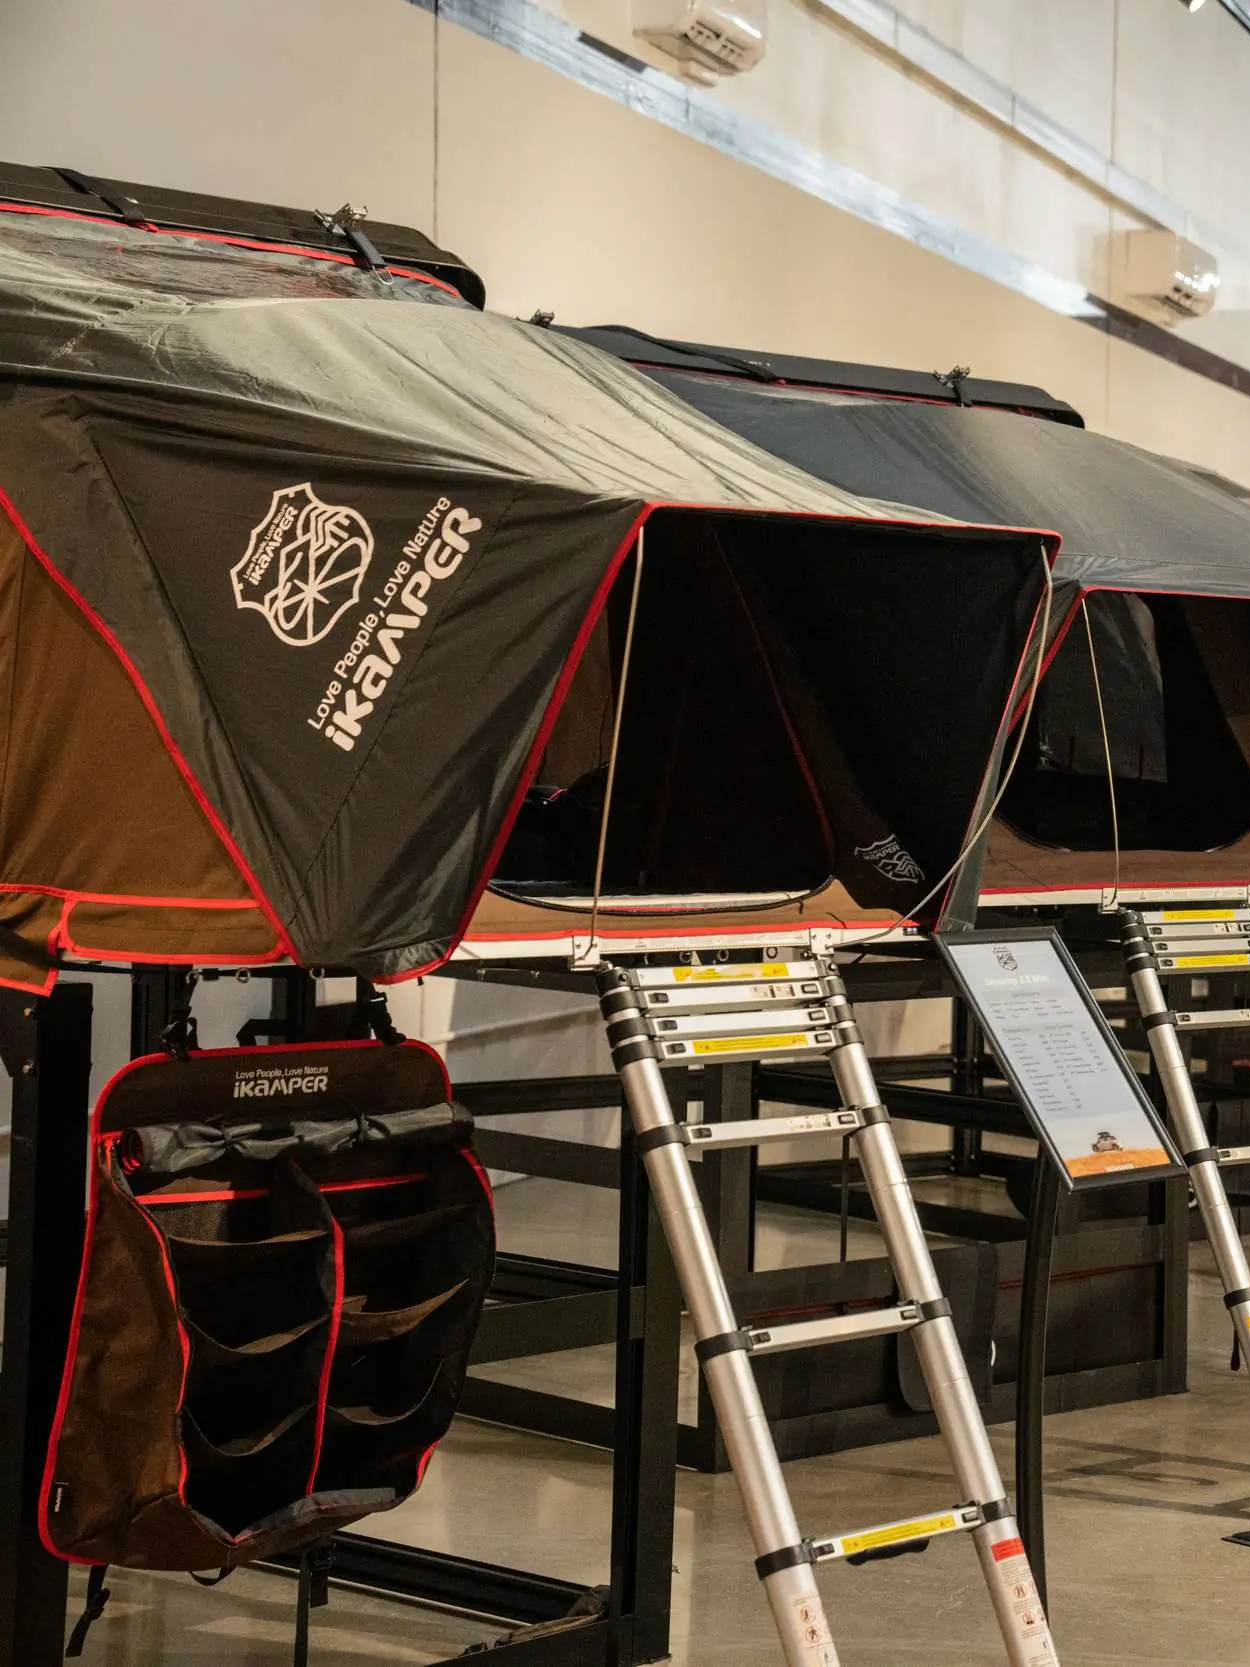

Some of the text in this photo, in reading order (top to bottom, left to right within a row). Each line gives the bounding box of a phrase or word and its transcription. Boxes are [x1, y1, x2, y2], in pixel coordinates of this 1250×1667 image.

[307, 681, 343, 730] Love
[372, 561, 410, 608] Love
[402, 496, 451, 559] Nature
[324, 507, 482, 752] iKAMPER
[233, 1075, 329, 1099] iKAMPER
[235, 1070, 255, 1080] Love
[285, 1066, 303, 1076] Love
[304, 1065, 329, 1075] Nature
